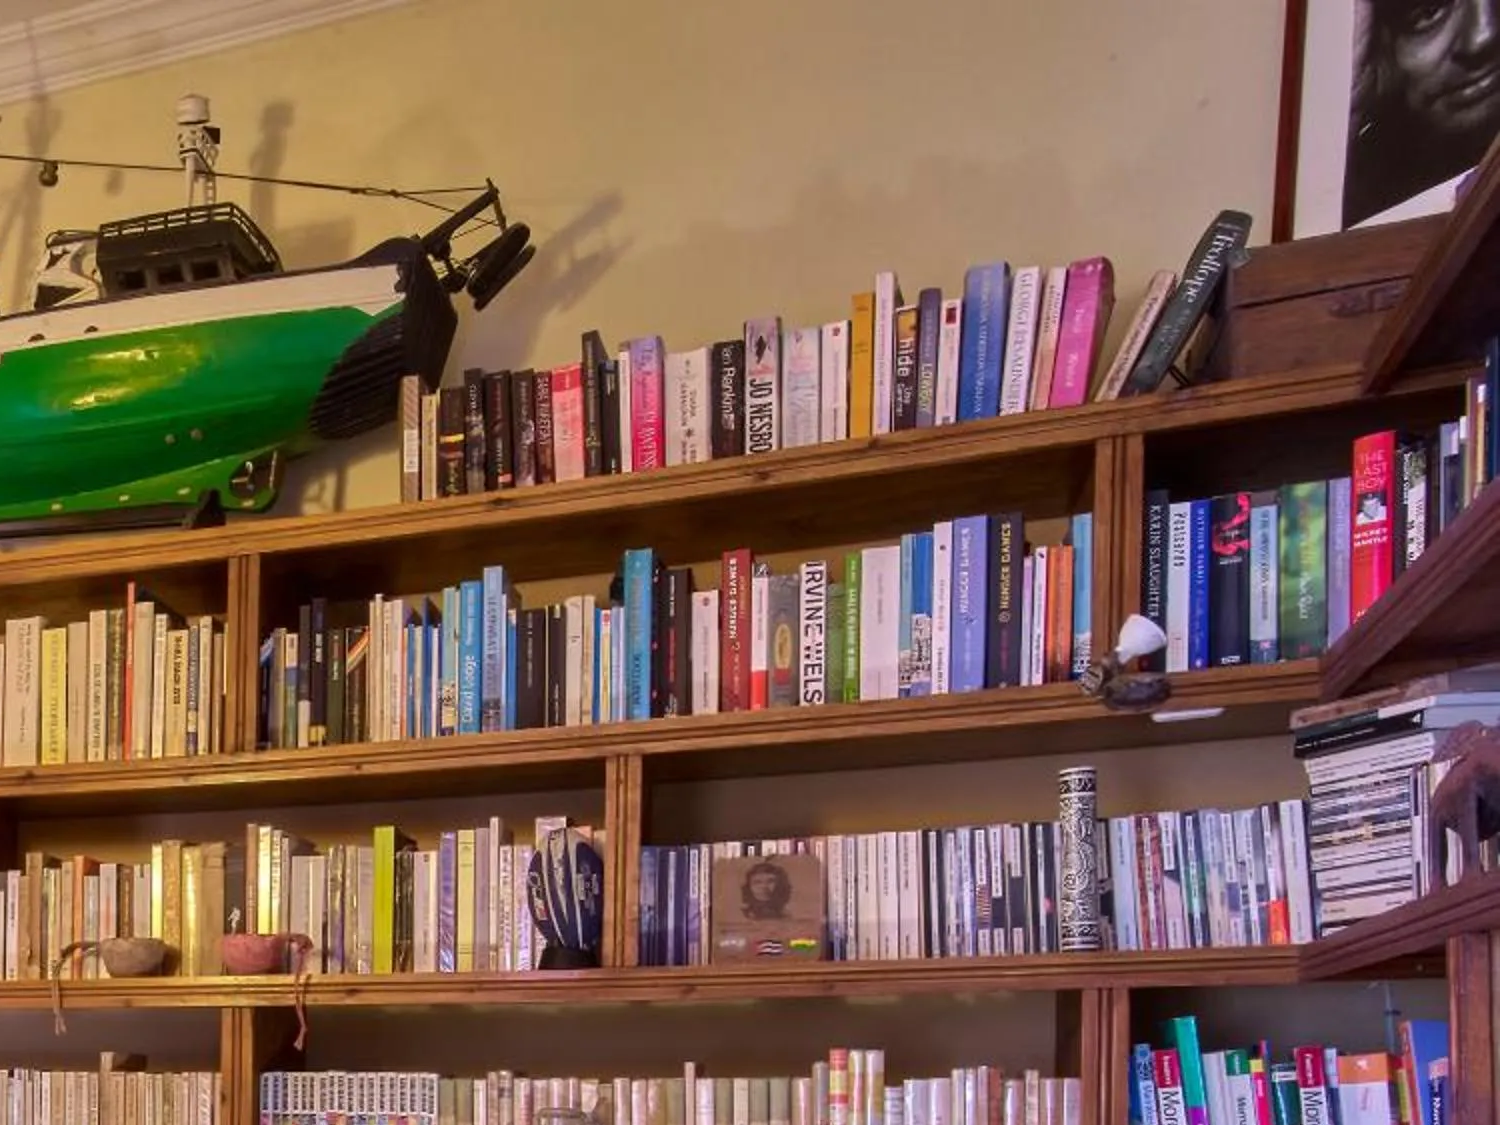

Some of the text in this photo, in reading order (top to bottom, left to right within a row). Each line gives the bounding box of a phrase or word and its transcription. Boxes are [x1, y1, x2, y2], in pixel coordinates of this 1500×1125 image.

[897, 337, 915, 377] hide
[749, 378, 773, 399] JO
[1355, 462, 1389, 478] LAST
[1359, 449, 1386, 465] THE
[1147, 504, 1162, 545] KARIN
[803, 562, 824, 638] IRVINE
